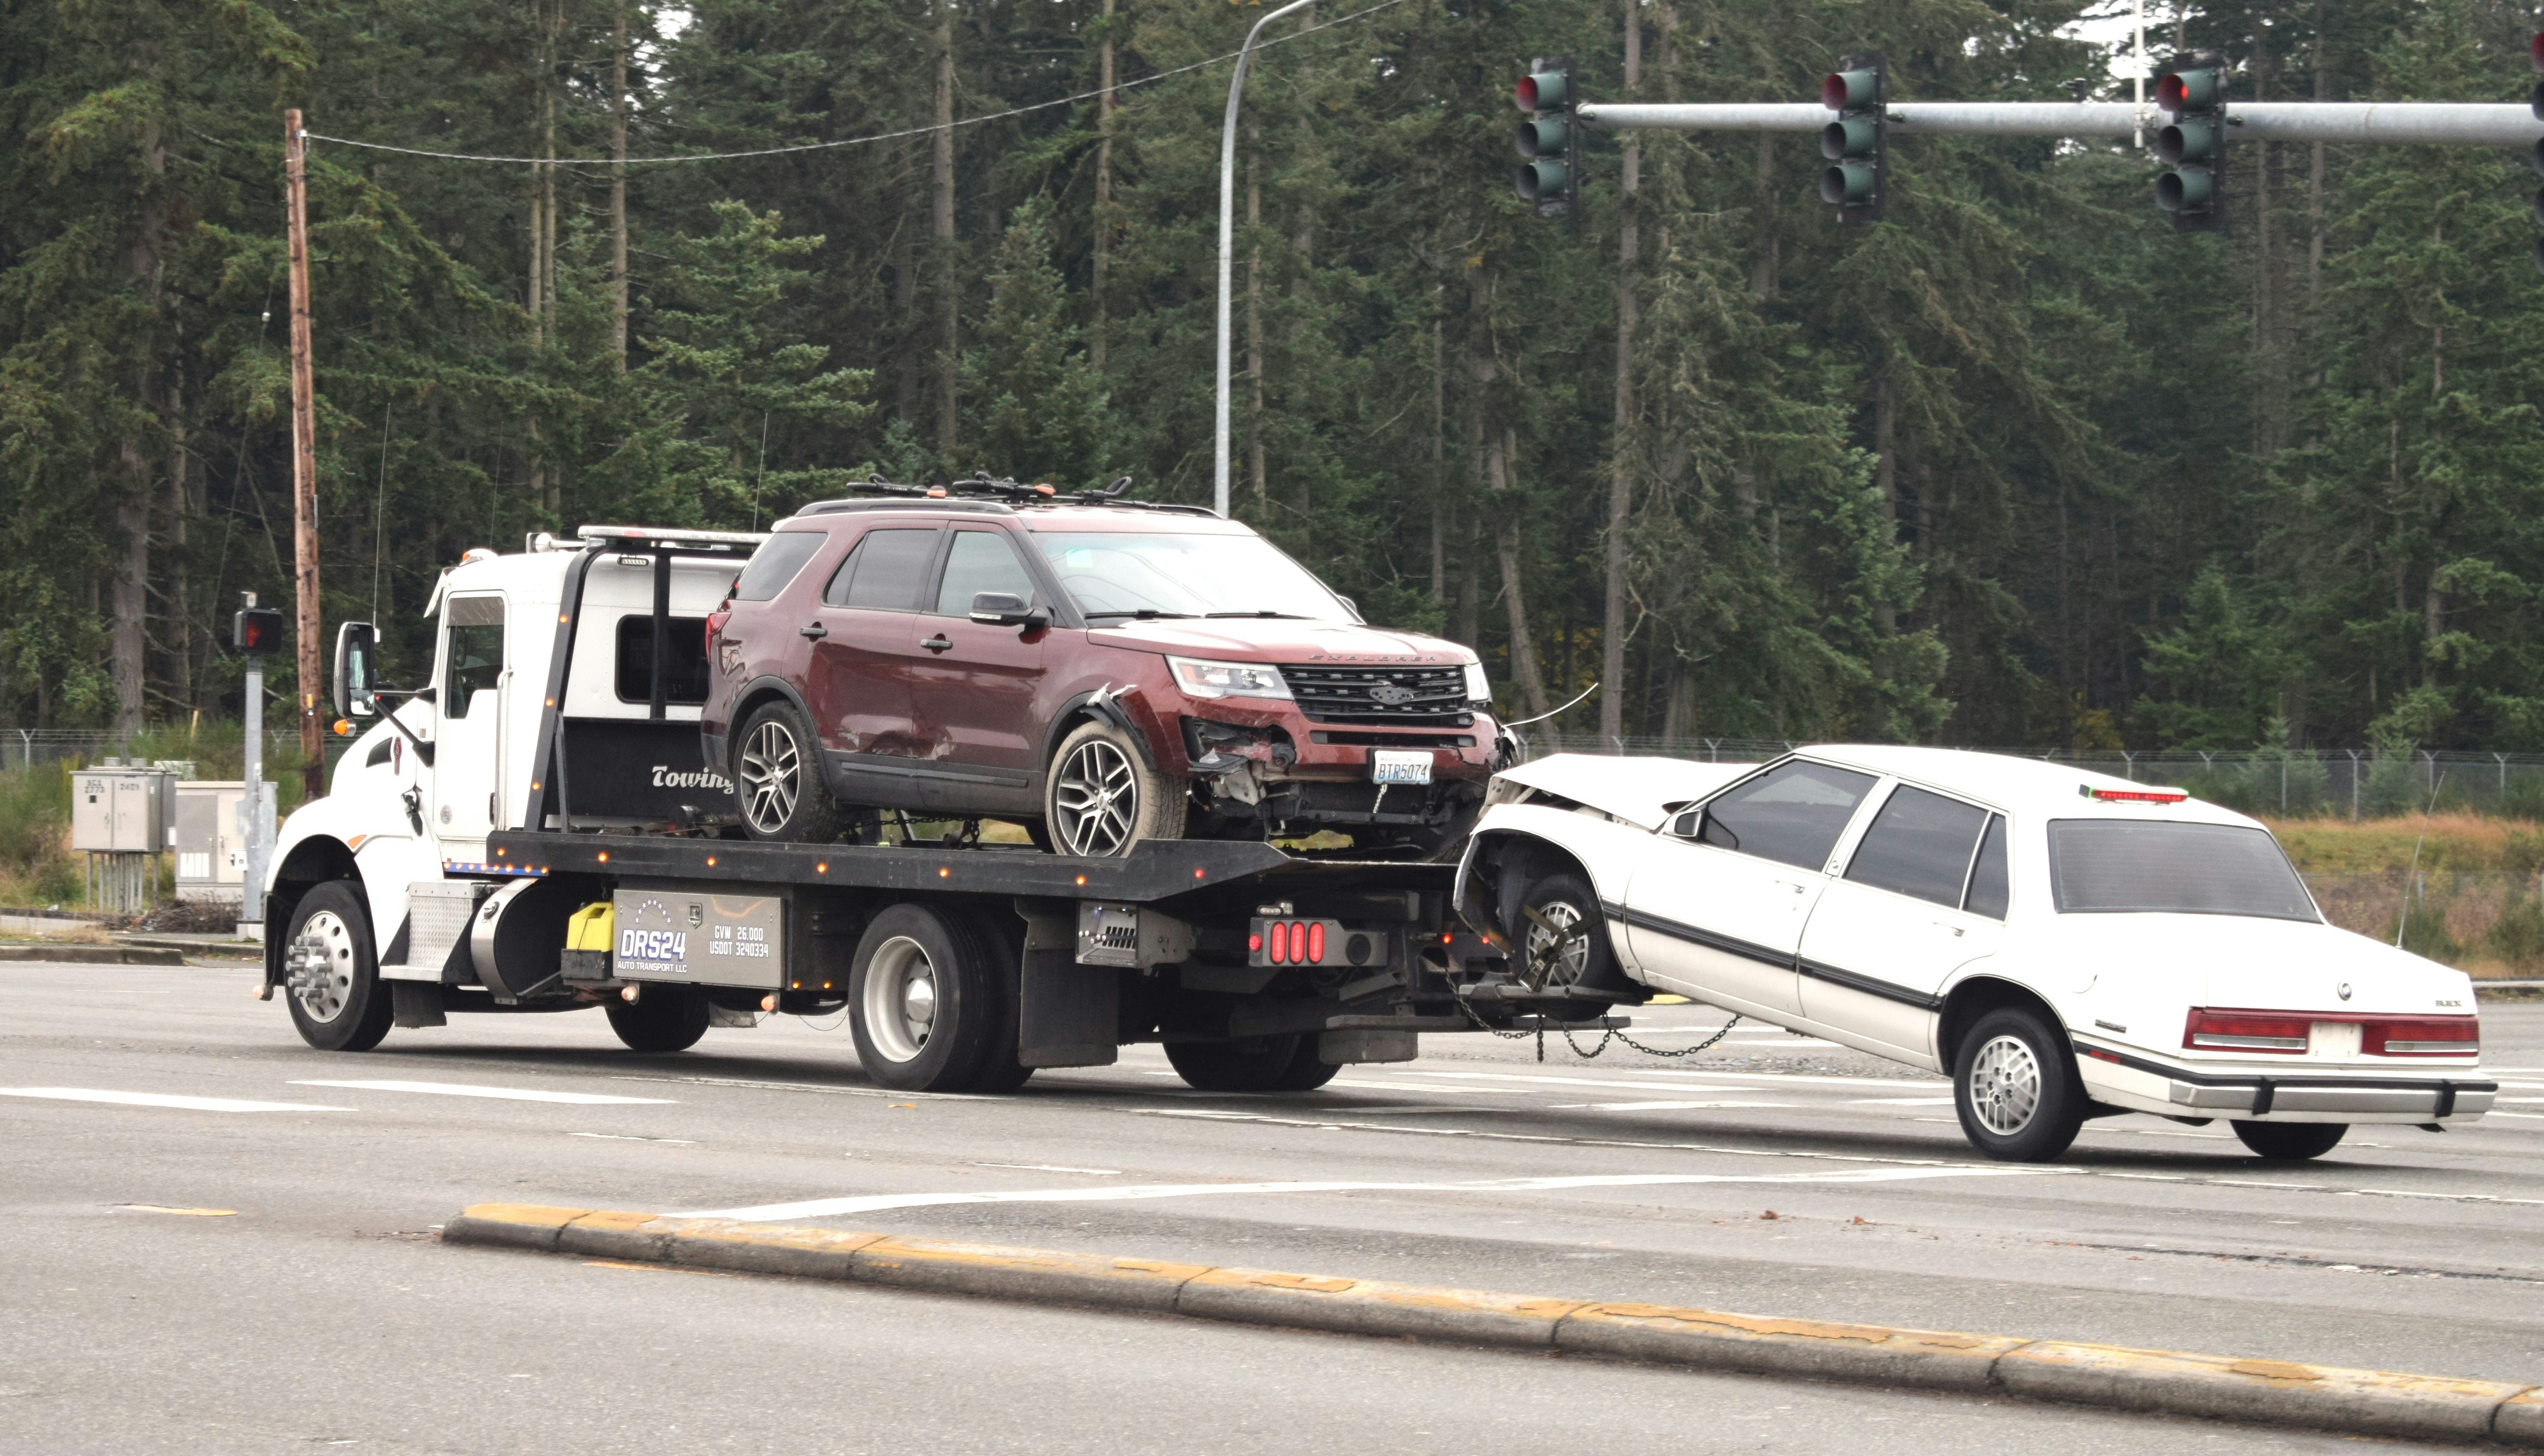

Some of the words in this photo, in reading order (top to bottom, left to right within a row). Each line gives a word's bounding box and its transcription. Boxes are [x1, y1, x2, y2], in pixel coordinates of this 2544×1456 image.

[652, 766, 734, 794] Towing
[1378, 764, 1428, 780] BTR5074
[715, 925, 731, 940] GVW
[620, 929, 686, 961] DRS24
[710, 941, 733, 955] USDOT
[735, 942, 768, 958] 3240334
[617, 961, 634, 970] AUTO
[636, 961, 674, 972] TRANSPORT
[675, 964, 687, 973] LLC
